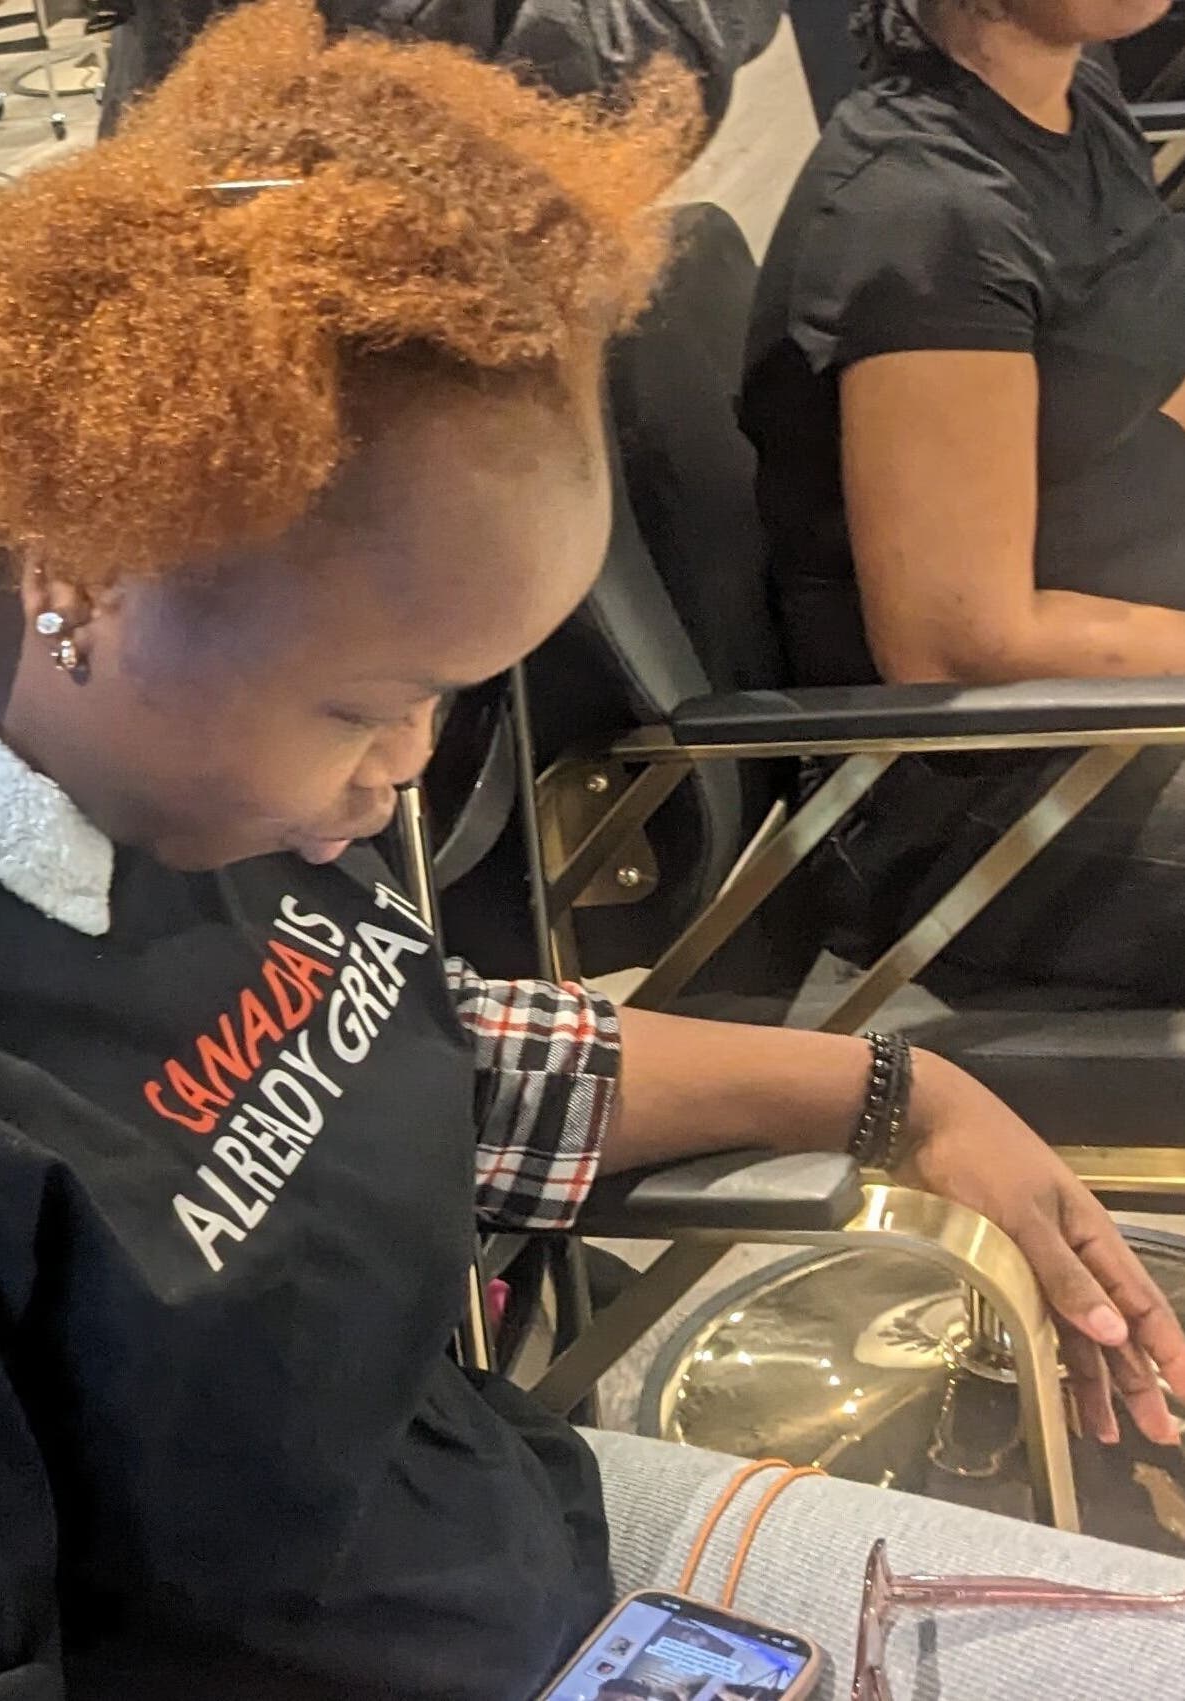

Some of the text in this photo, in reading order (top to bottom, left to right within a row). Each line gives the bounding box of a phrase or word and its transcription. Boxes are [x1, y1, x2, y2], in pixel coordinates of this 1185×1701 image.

[143, 894, 345, 1134] CANADA IS
[172, 1029, 344, 1272] ALREADY
